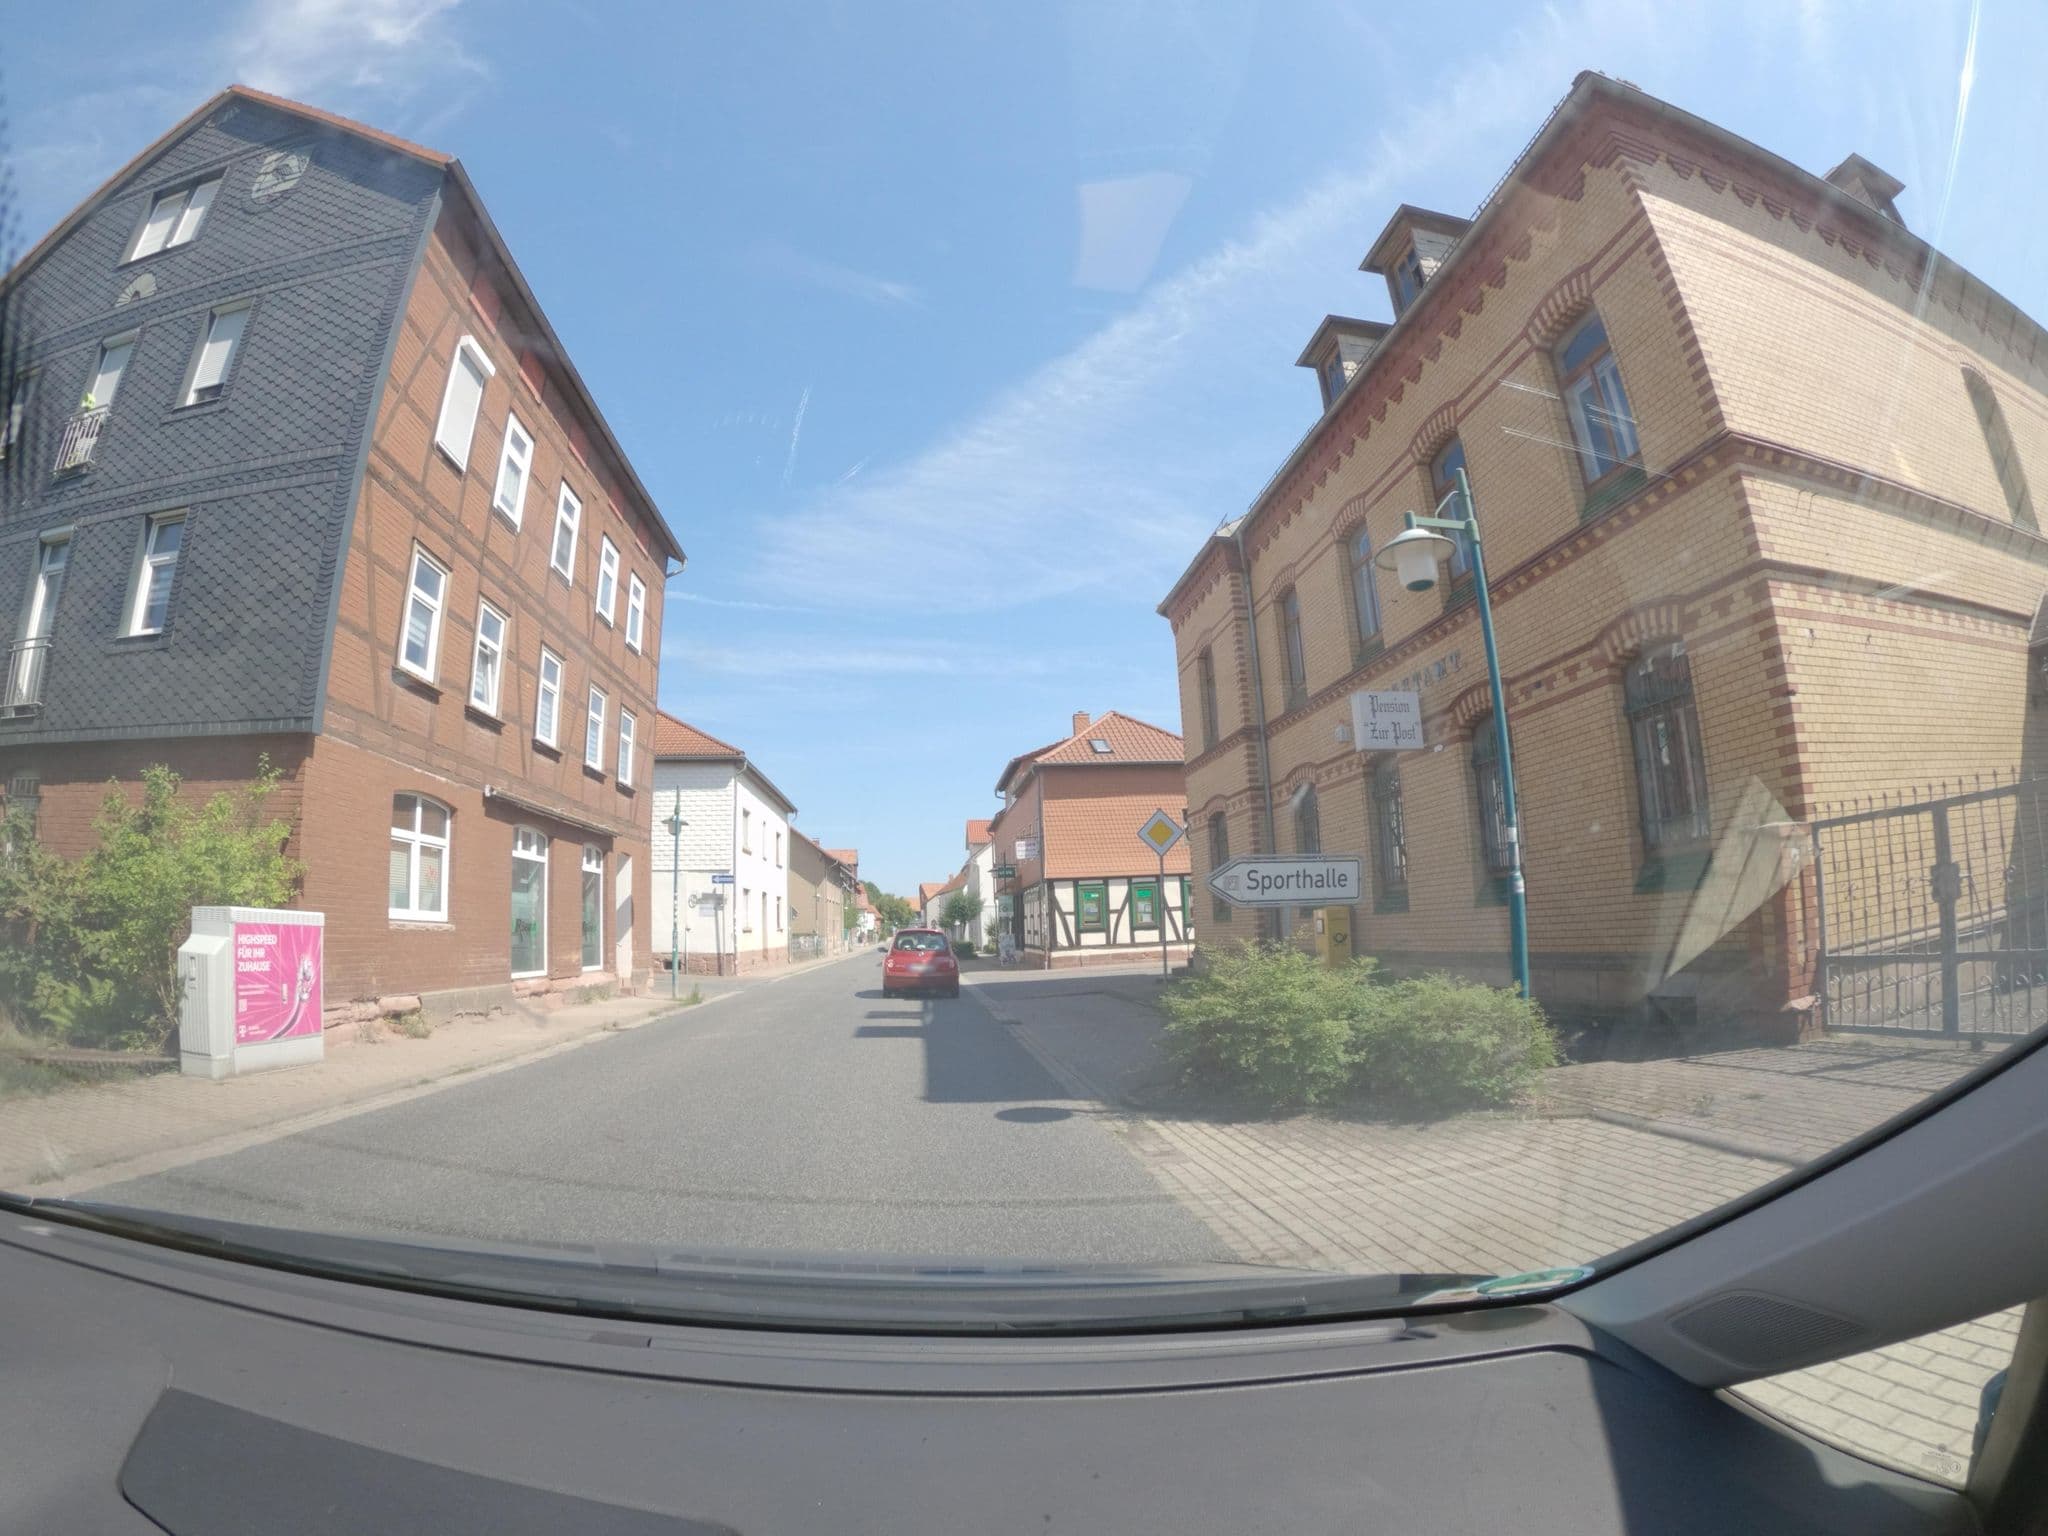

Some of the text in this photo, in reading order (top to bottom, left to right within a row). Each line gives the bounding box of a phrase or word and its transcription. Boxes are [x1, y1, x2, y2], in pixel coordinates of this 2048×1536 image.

[1369, 694, 1411, 718] Pension
[1246, 868, 1348, 896] Sporthalle
[238, 934, 277, 944] HIGHSPEED
[238, 945, 265, 958] FÜR IHR
[238, 961, 270, 972] ZUHAUSE
